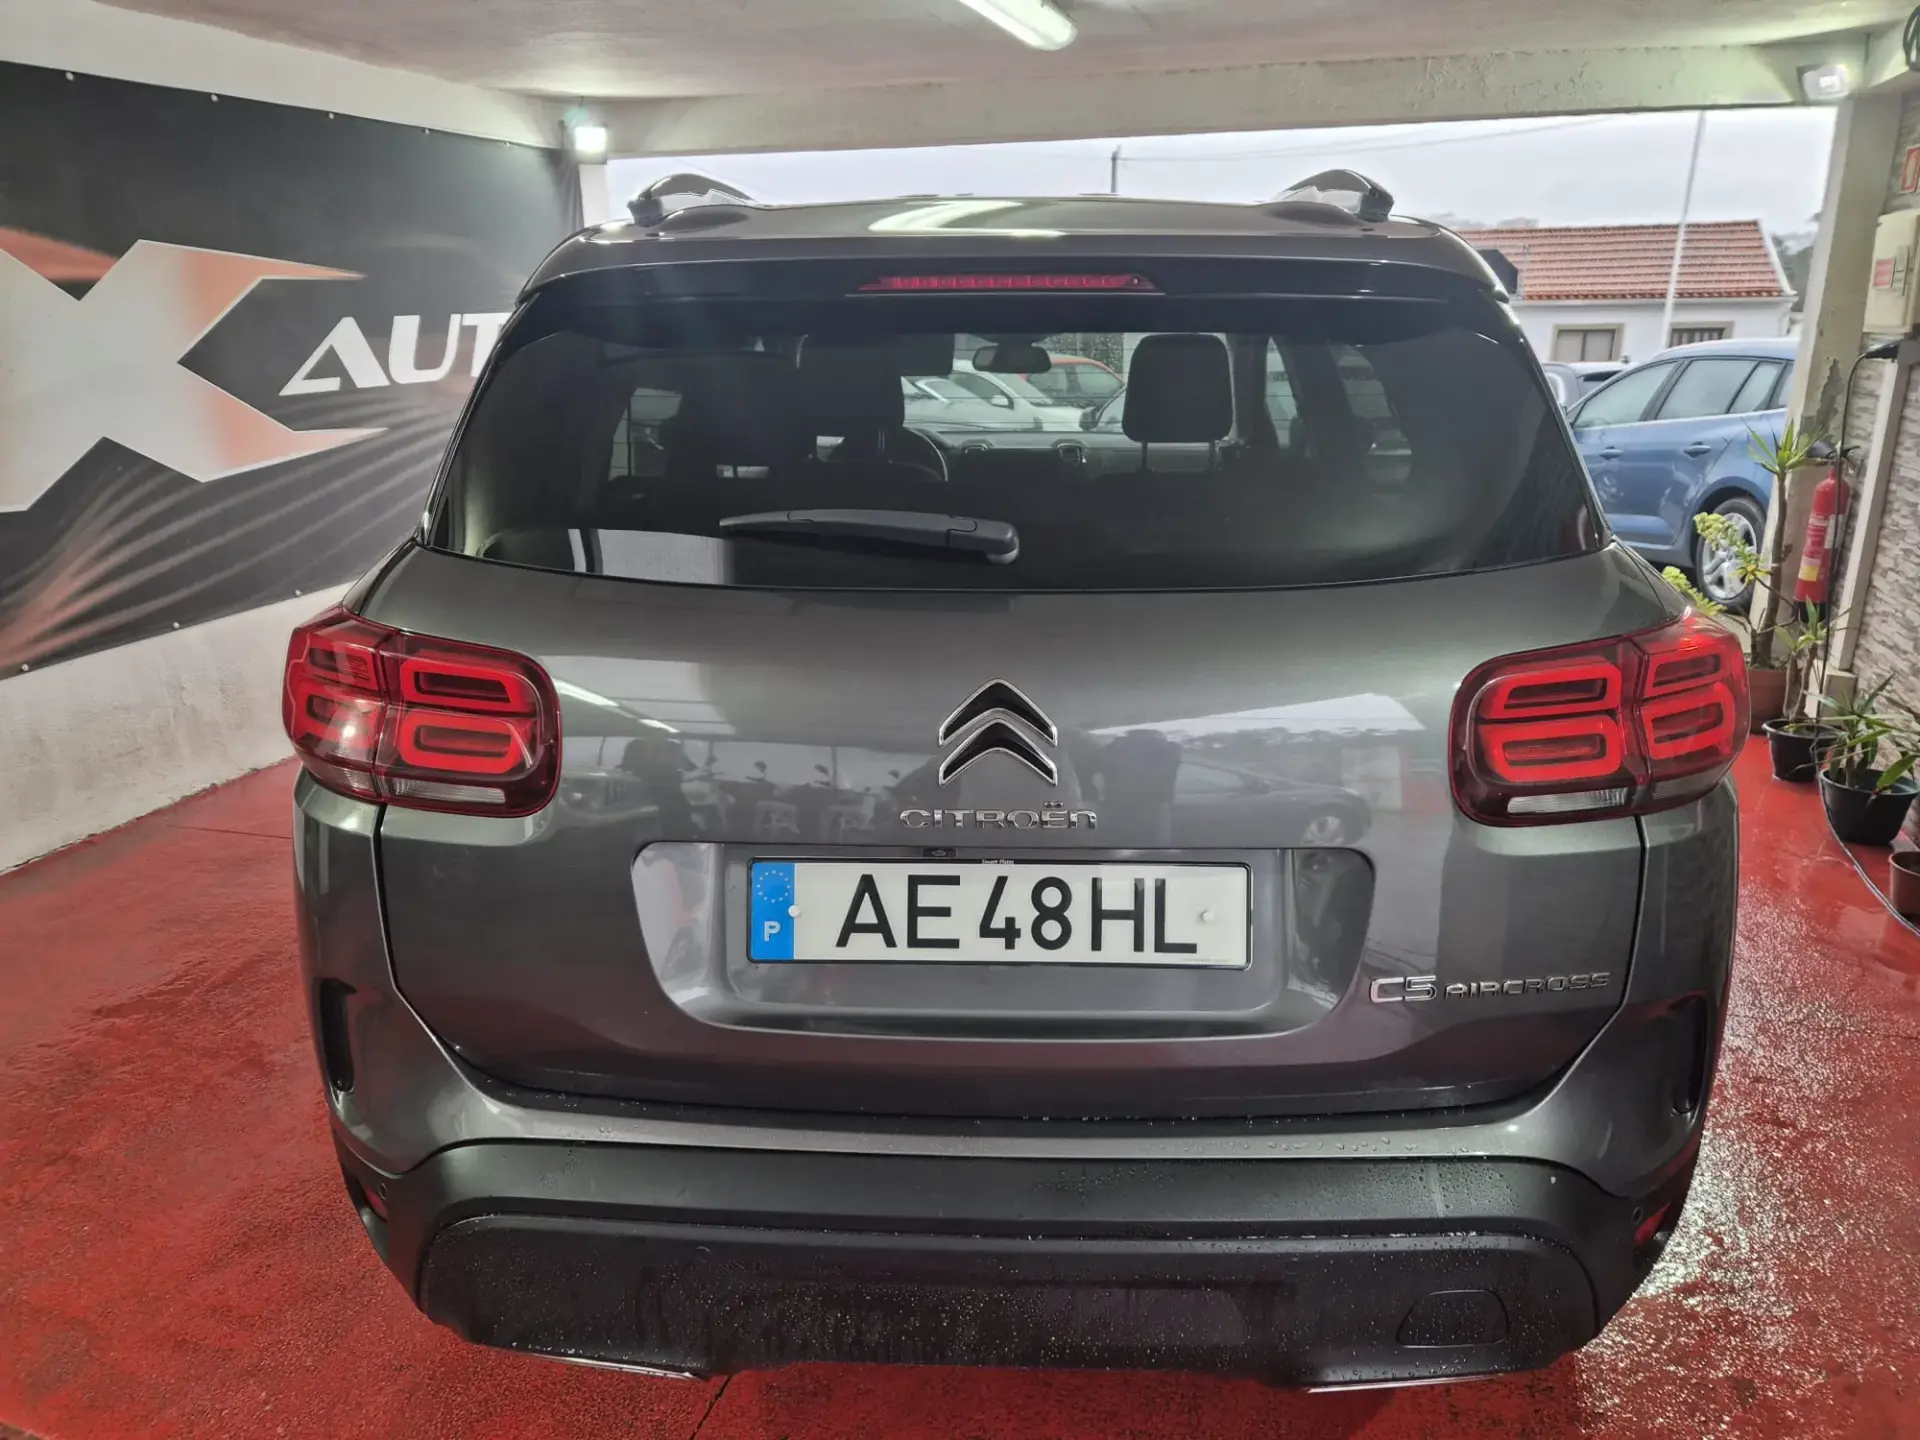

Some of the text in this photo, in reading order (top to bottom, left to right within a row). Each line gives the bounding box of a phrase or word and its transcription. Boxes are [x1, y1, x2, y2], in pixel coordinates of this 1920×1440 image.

[763, 921, 781, 942] P
[1370, 972, 1610, 1003] C5 AIRCROSS
